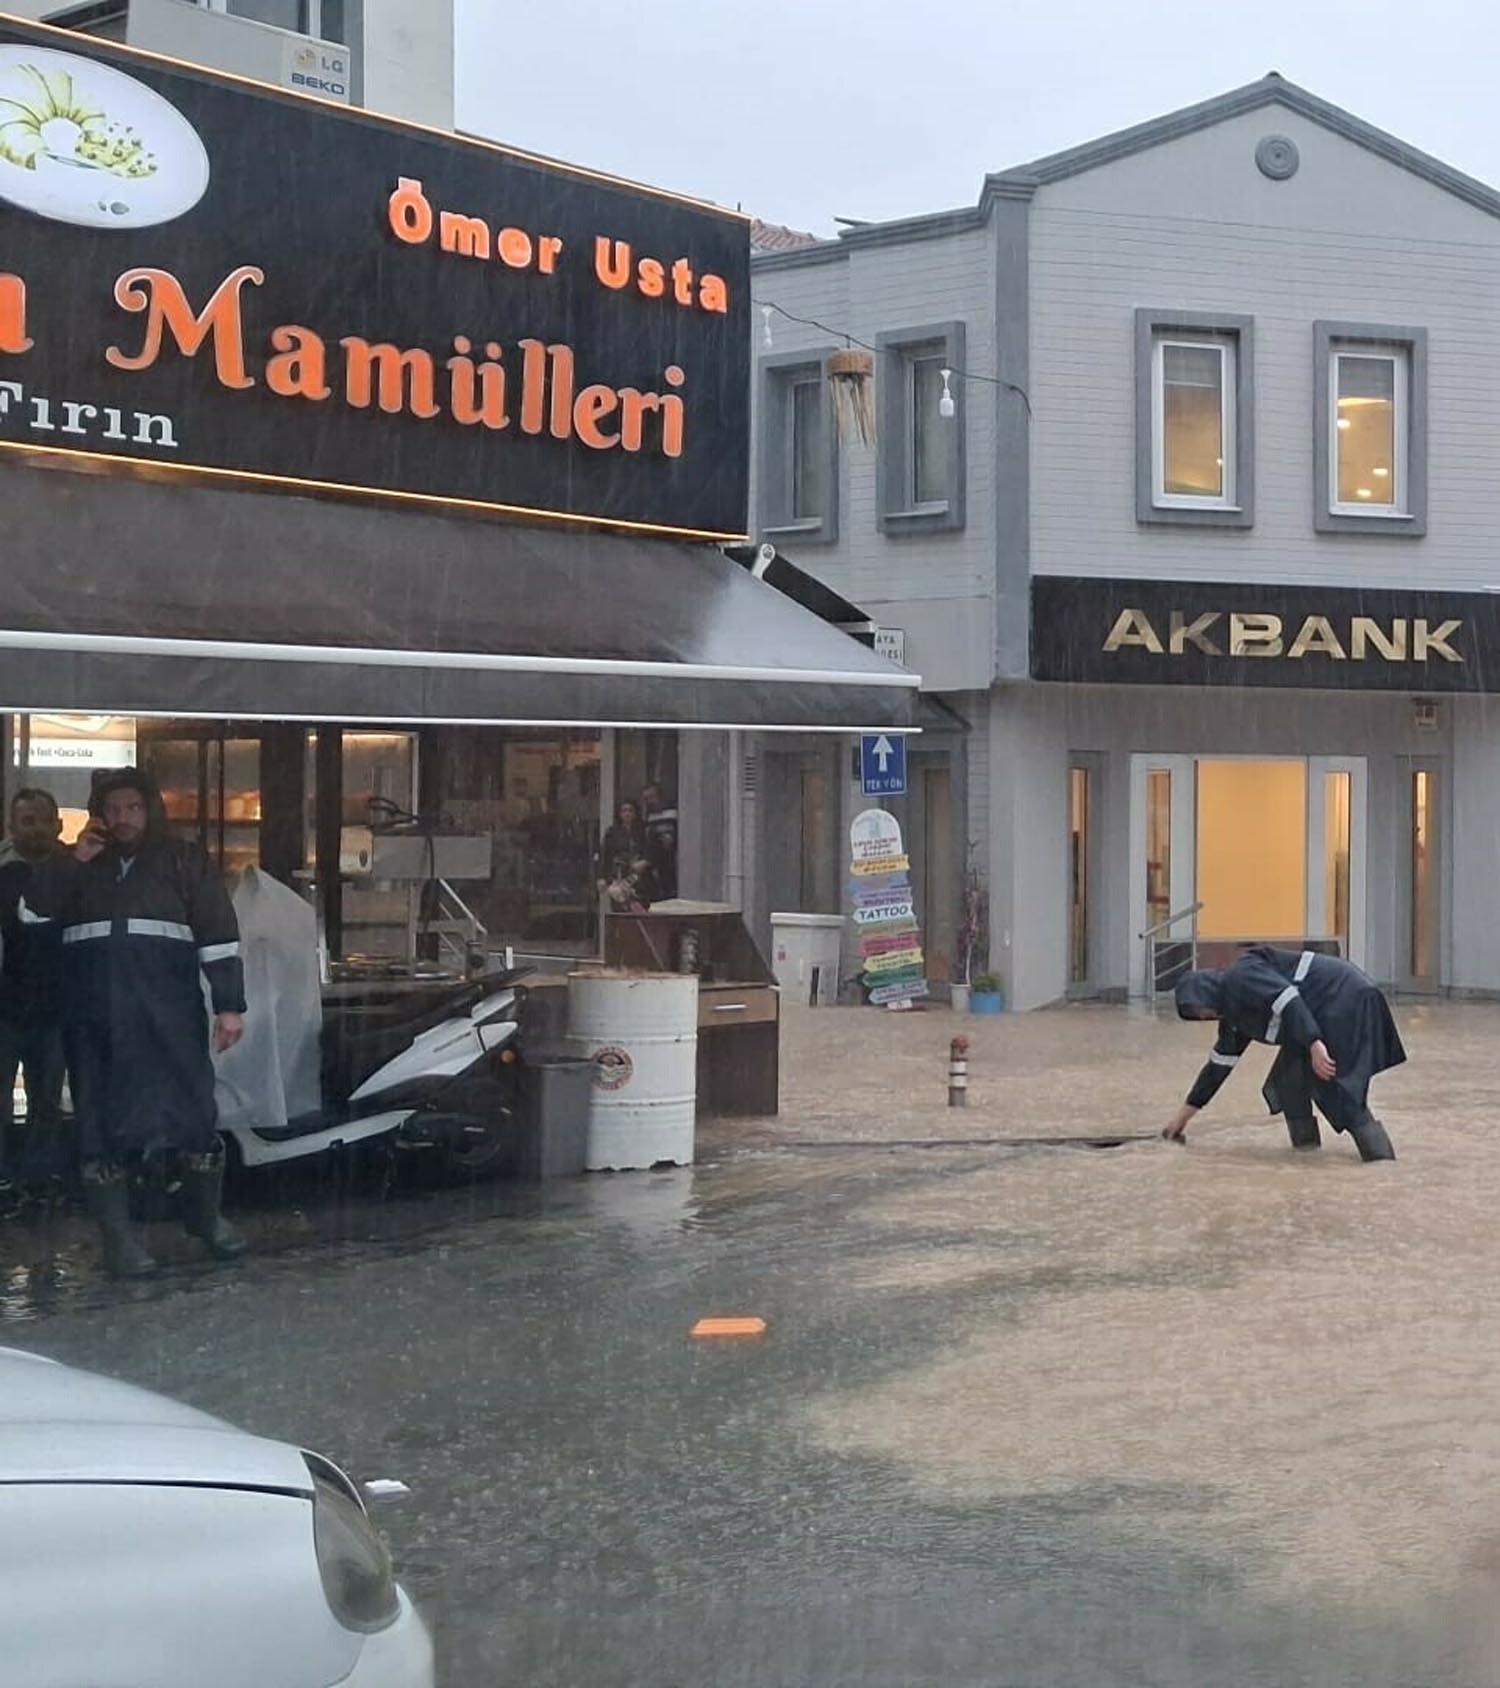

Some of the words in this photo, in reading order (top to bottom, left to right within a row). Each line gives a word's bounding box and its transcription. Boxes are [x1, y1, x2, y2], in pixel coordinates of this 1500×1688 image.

[291, 72, 345, 95] BEKO
[596, 236, 727, 313] Usta
[106, 266, 684, 457] Mamülleri
[1101, 608, 1464, 662] AKBANK
[859, 905, 908, 919] TATTOO
